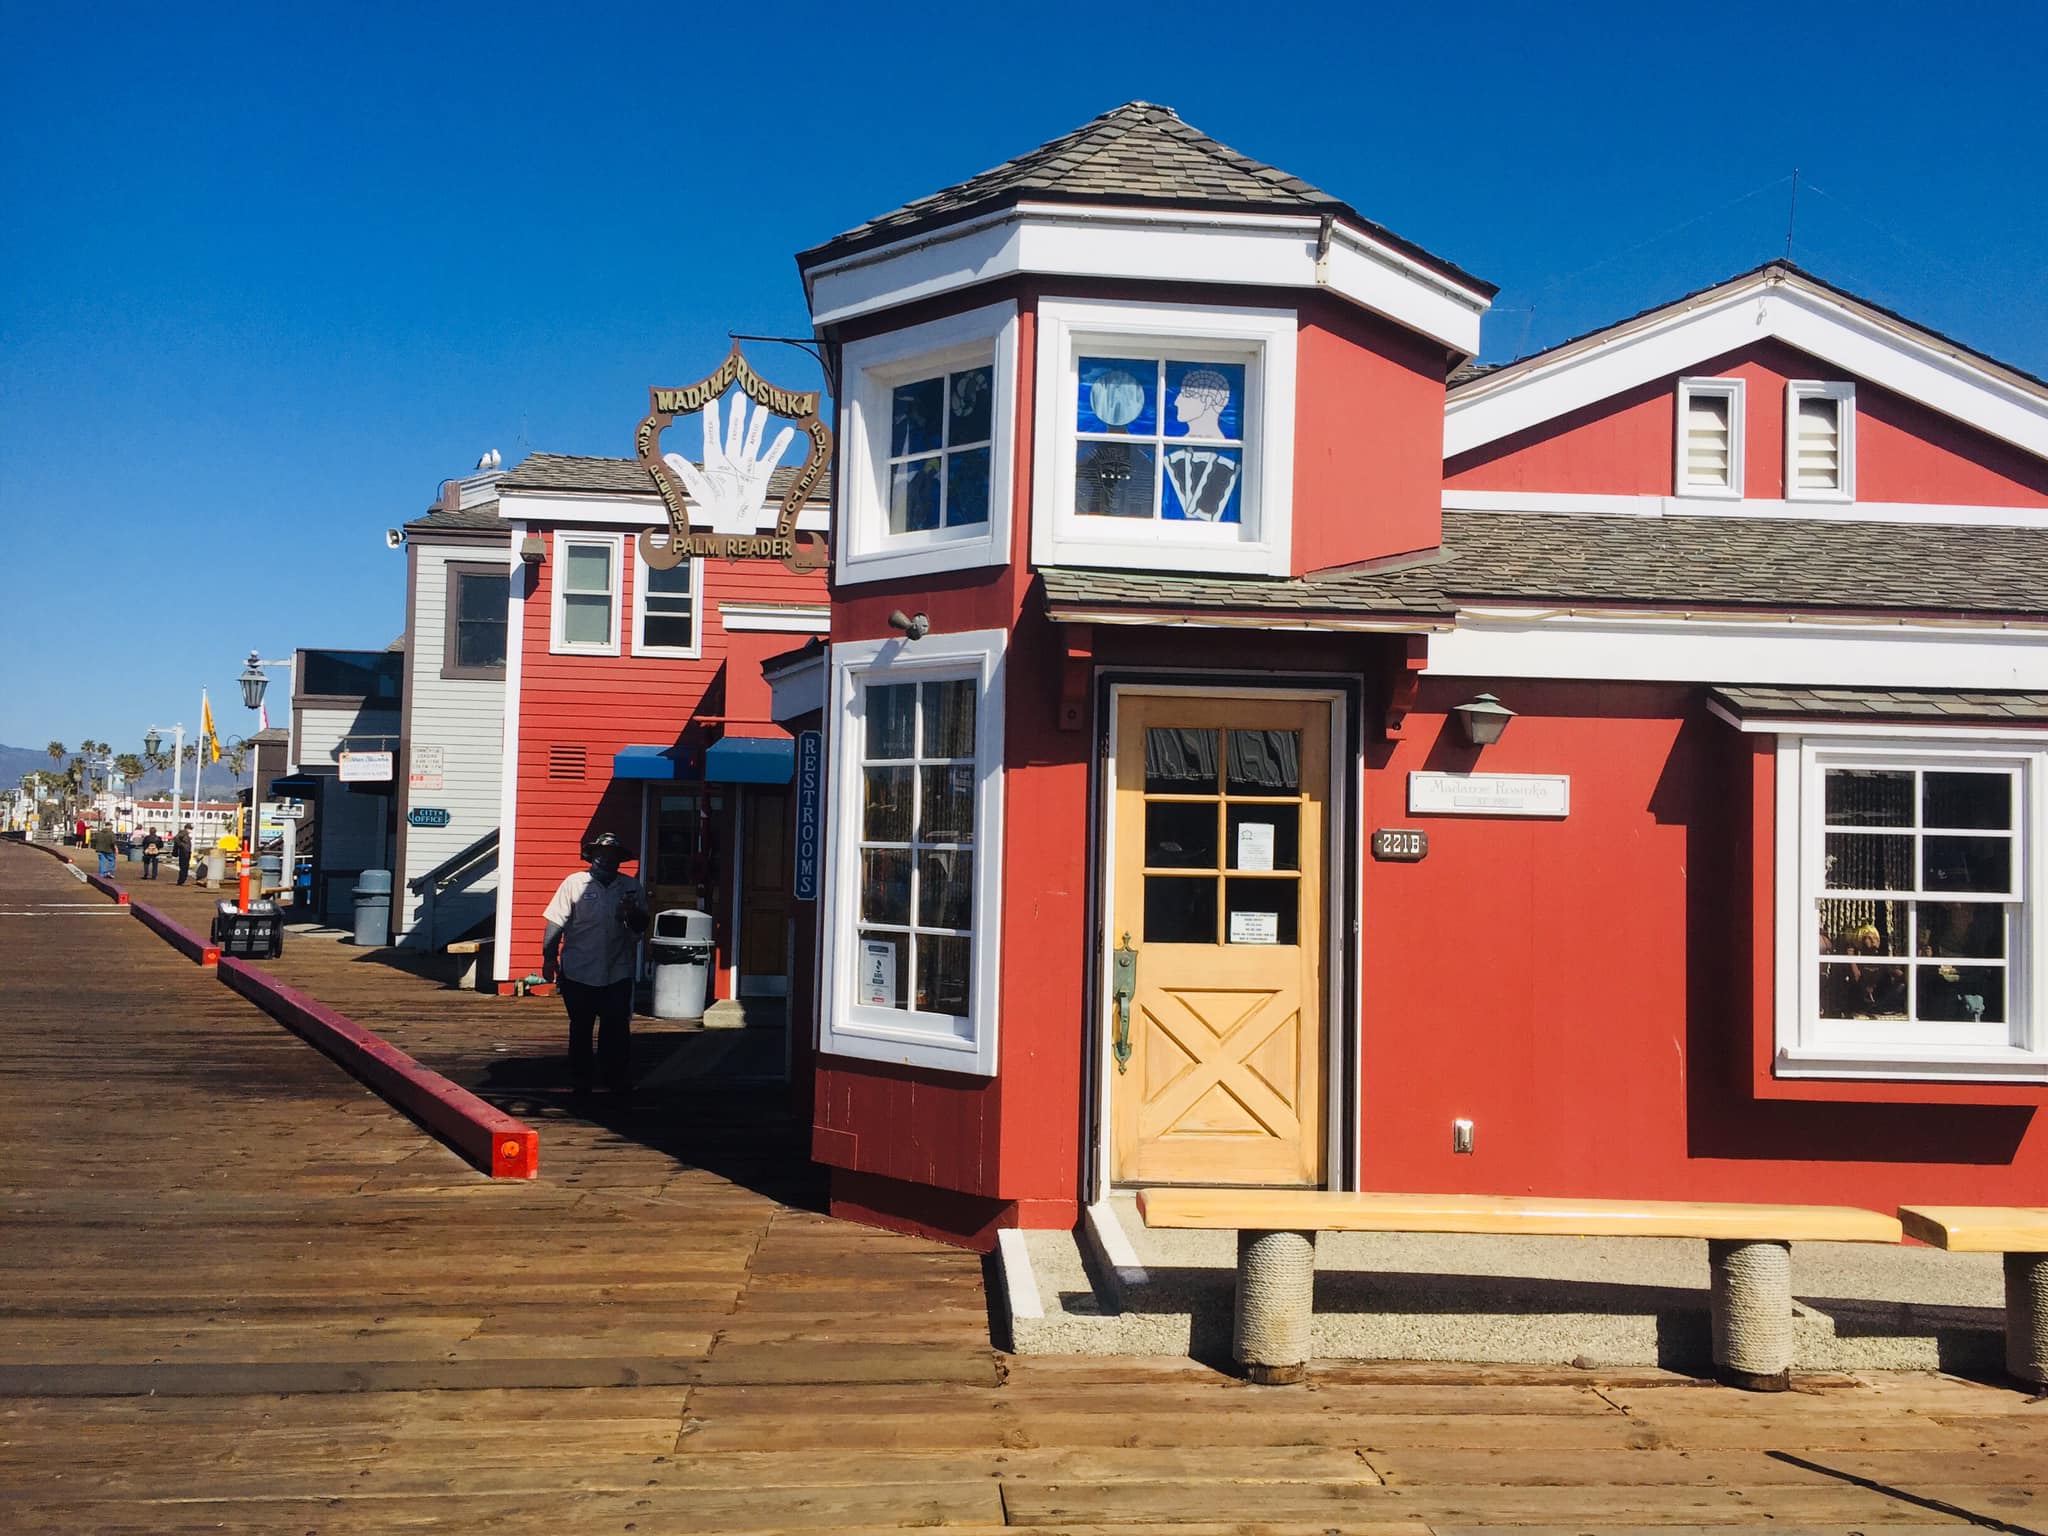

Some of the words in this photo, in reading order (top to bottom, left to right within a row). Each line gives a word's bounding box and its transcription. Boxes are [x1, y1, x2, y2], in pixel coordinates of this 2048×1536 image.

[655, 354, 734, 411] MADAME
[736, 355, 814, 415] ROSINKA
[639, 416, 656, 456] PAST
[800, 422, 826, 490] FUTURE
[650, 464, 684, 531] PRESENT
[780, 490, 803, 536] TOLD
[672, 538, 719, 556] PALM
[726, 539, 793, 557] READER
[414, 815, 444, 823] OFFICE
[800, 738, 817, 893] RESTROOMS
[1382, 833, 1421, 854] 221B
